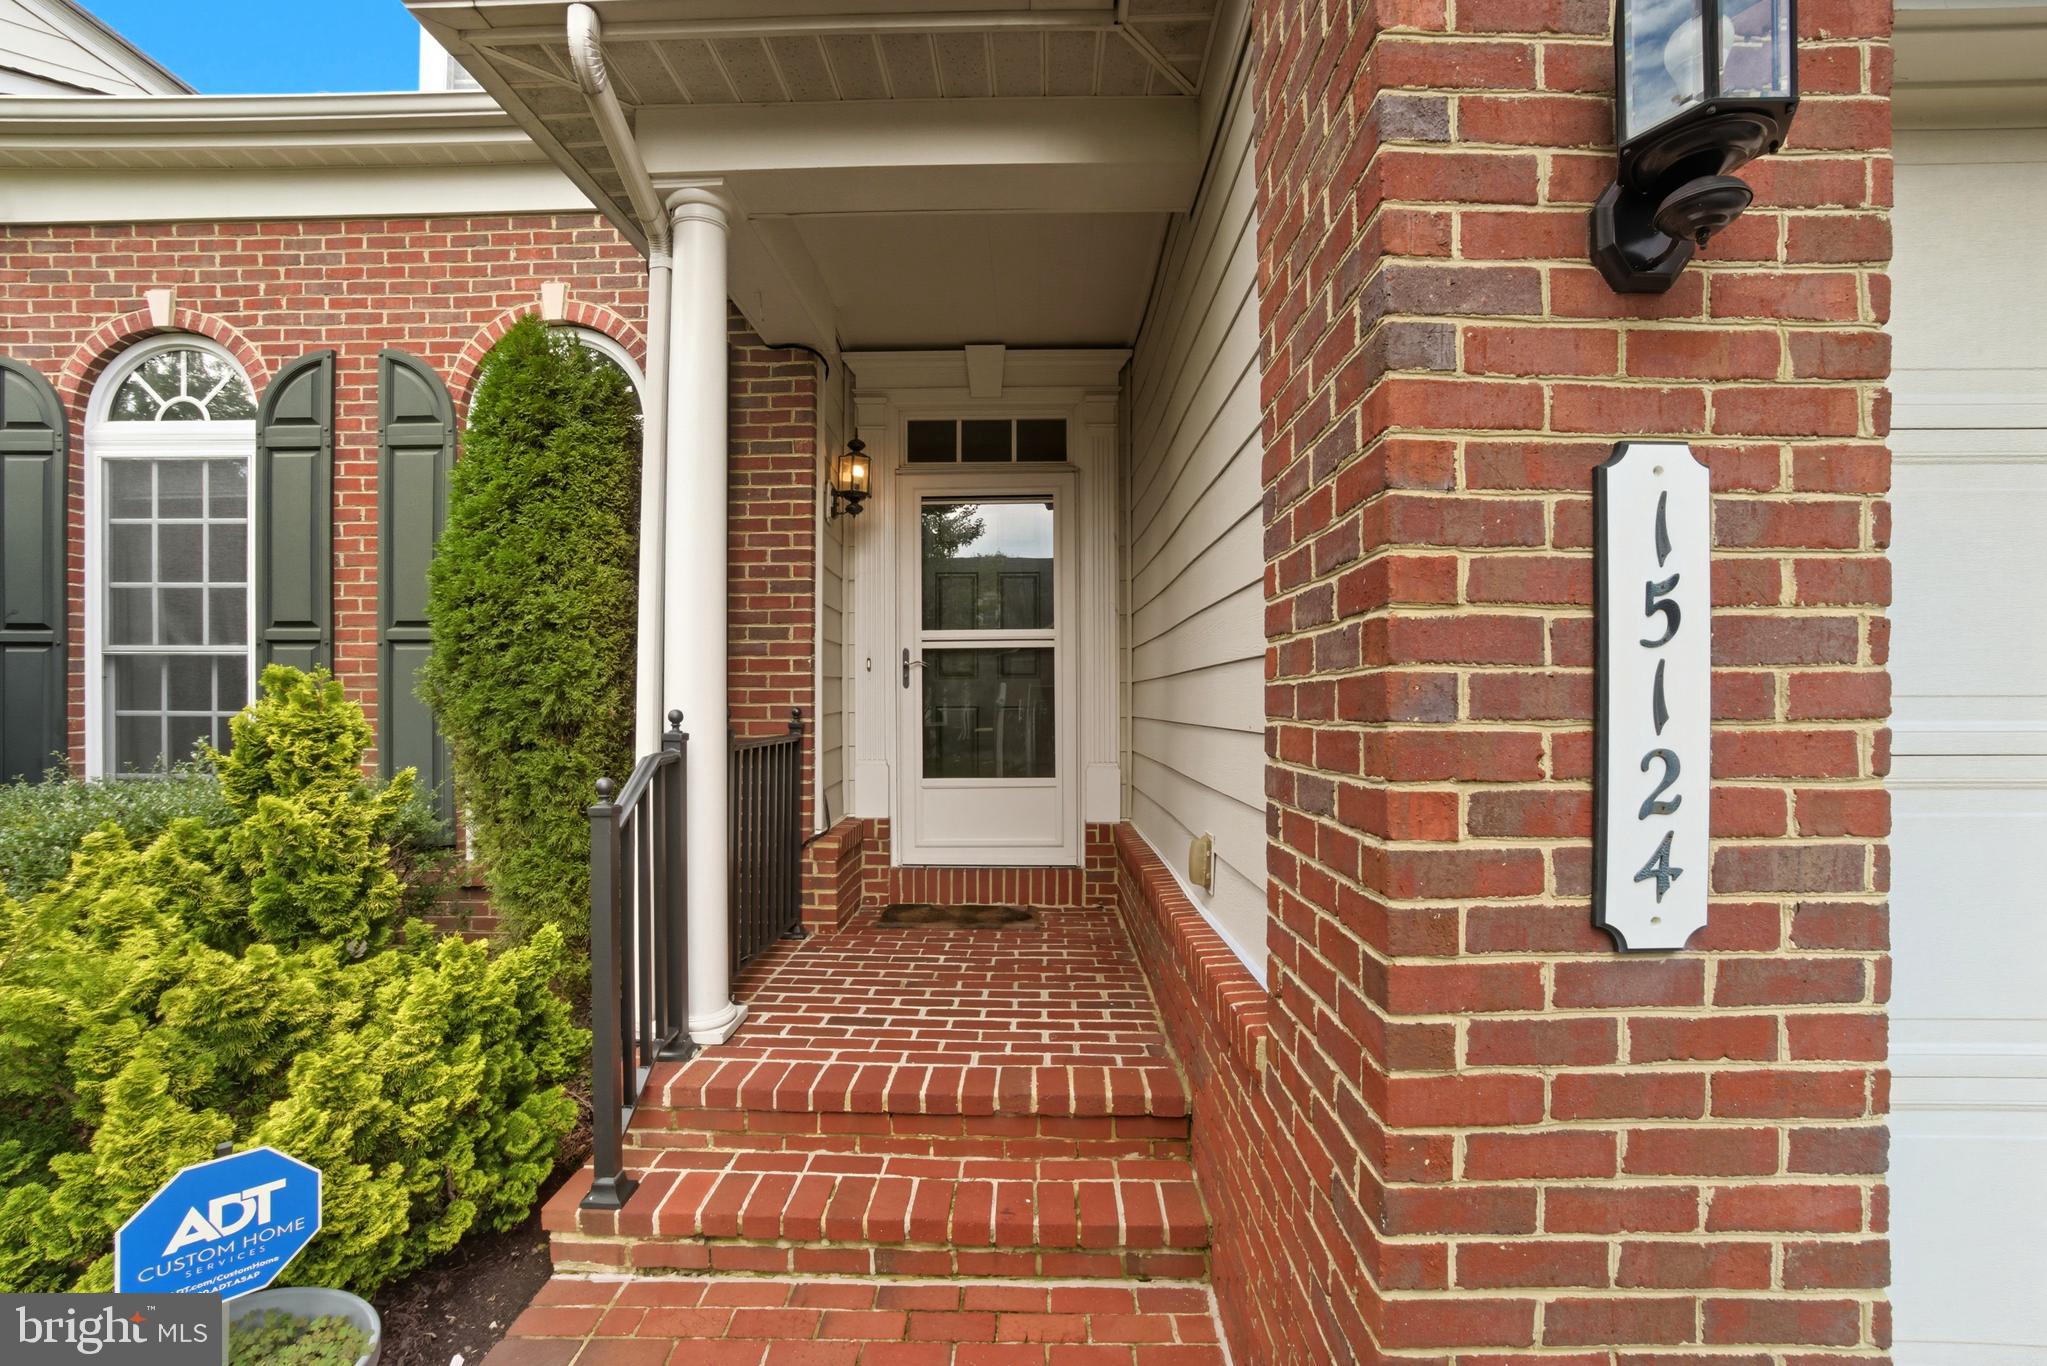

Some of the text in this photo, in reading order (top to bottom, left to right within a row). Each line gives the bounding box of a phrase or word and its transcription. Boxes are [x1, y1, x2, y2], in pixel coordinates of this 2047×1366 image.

[1634, 490, 1684, 903] 15124
[137, 1217, 305, 1282] CUSTOM HOME
[161, 1178, 287, 1257] ADT
[185, 1245, 266, 1278] SERVICES
